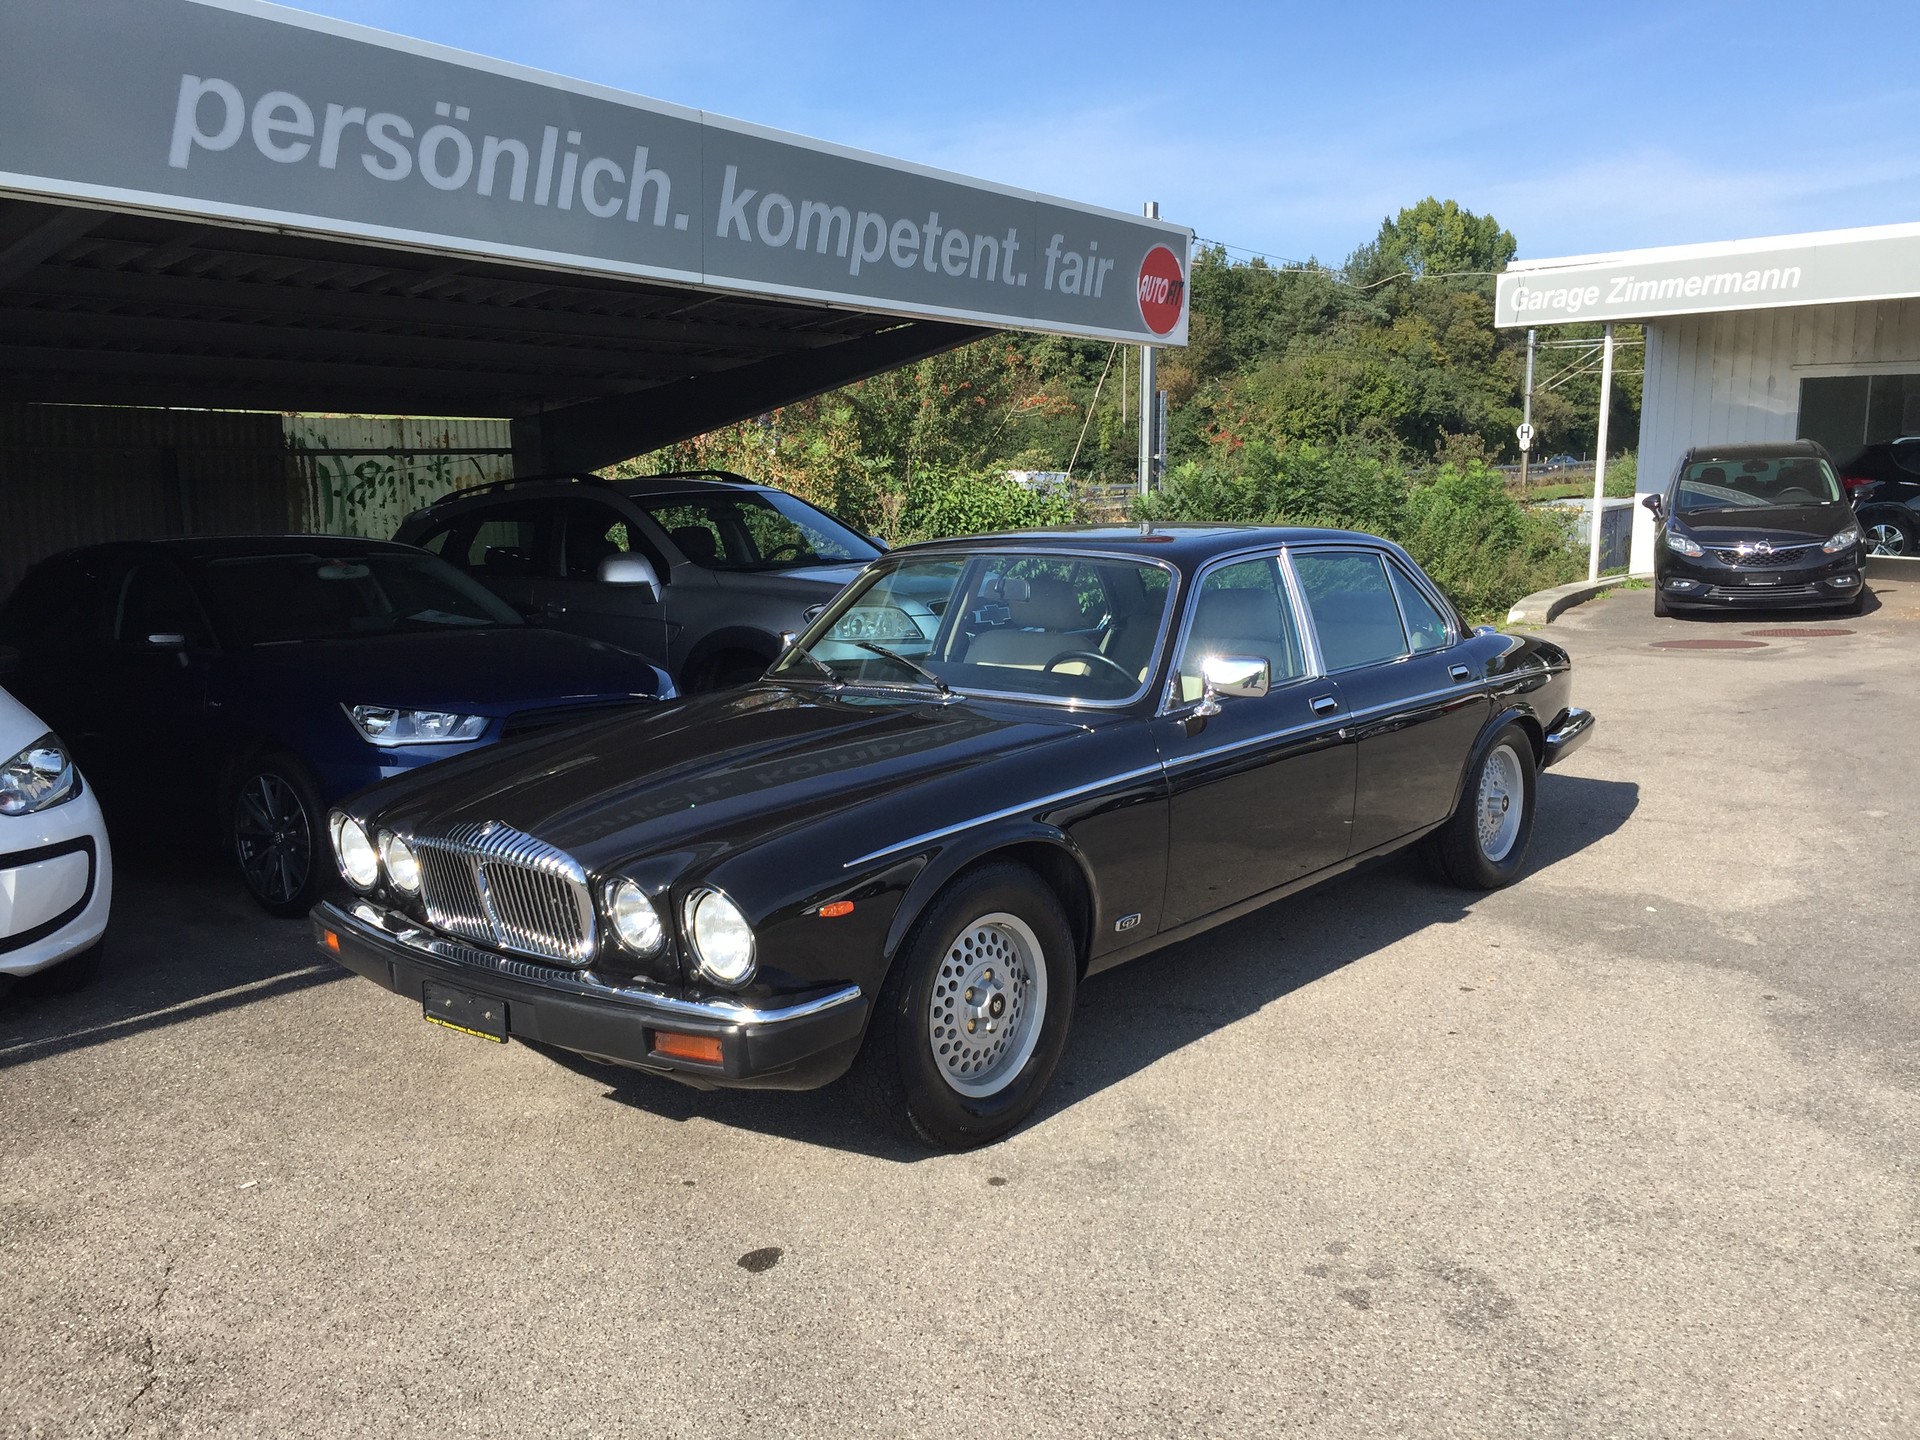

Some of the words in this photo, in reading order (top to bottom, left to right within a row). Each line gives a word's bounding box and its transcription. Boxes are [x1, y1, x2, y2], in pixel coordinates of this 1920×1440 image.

[169, 73, 689, 231] persönlich.
[716, 164, 1028, 287] kompetent.
[1044, 233, 1114, 298] fair
[1510, 284, 1600, 313] Garage
[1605, 266, 1801, 304] Zimmermann
[1520, 425, 1530, 439] H
